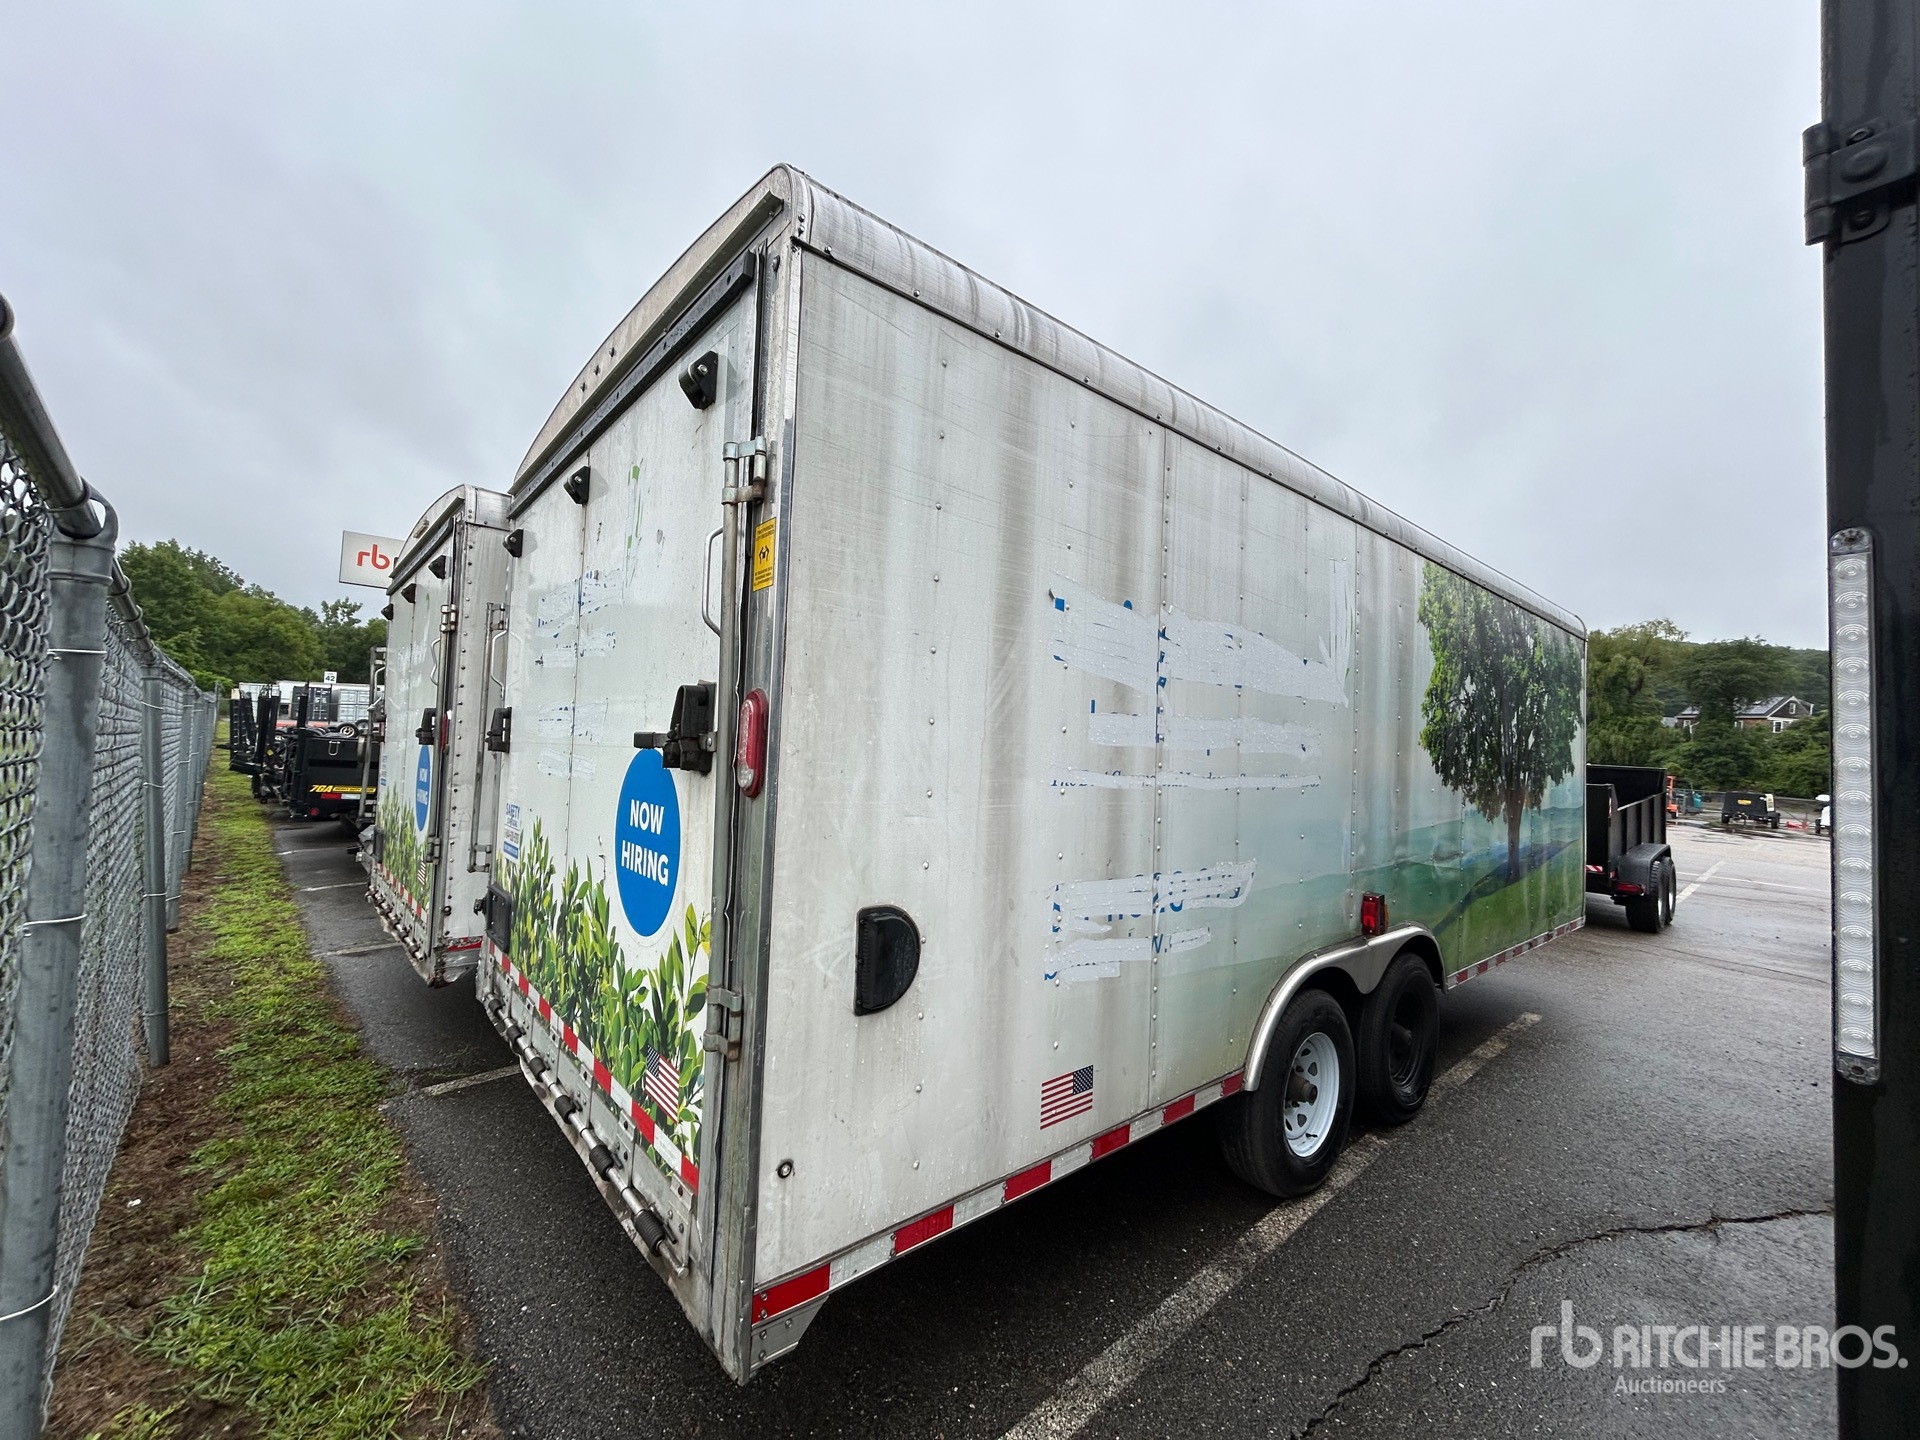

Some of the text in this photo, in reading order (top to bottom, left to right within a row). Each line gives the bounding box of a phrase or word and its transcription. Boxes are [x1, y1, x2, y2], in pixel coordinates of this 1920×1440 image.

[357, 544, 390, 570] rb
[629, 798, 665, 835] NOW
[621, 839, 669, 887] HIRING
